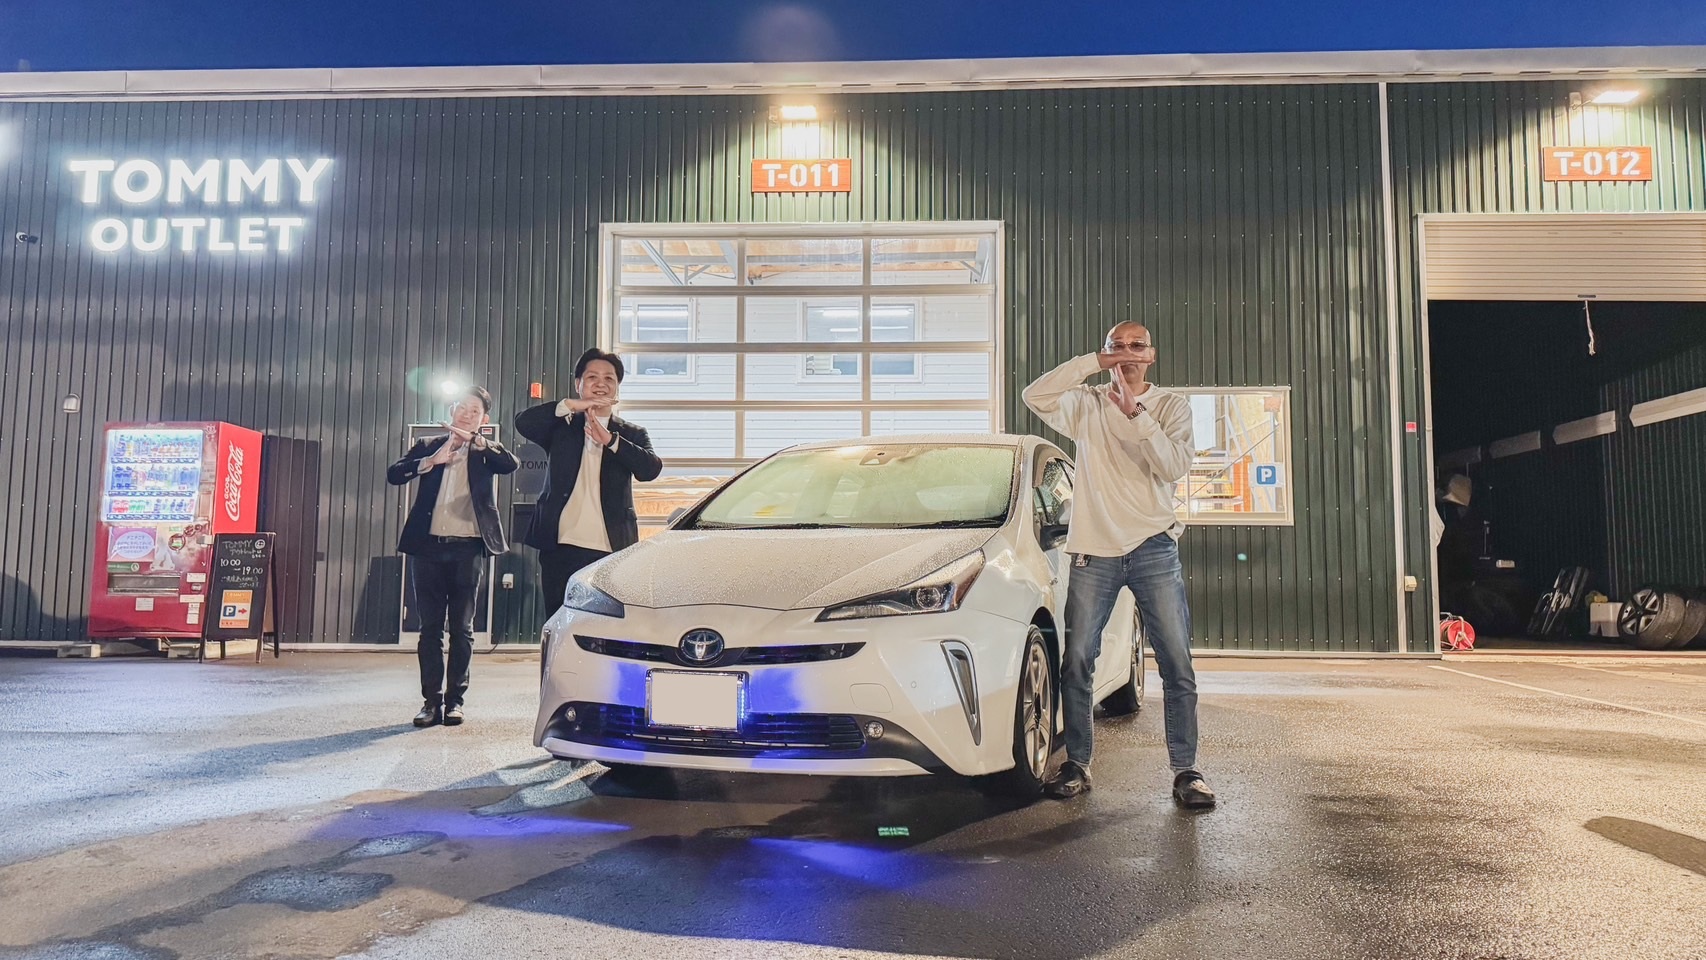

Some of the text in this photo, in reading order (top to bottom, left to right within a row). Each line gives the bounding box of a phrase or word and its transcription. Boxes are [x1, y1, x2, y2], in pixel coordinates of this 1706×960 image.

[761, 163, 839, 188] T-011
[1552, 151, 1641, 176] T-012
[68, 158, 334, 203] TOMMY
[91, 217, 304, 251] OUTLET
[225, 440, 244, 521] Coca-Cola
[1261, 468, 1272, 482] P
[222, 540, 253, 549] TOMMY
[225, 607, 235, 616] P
